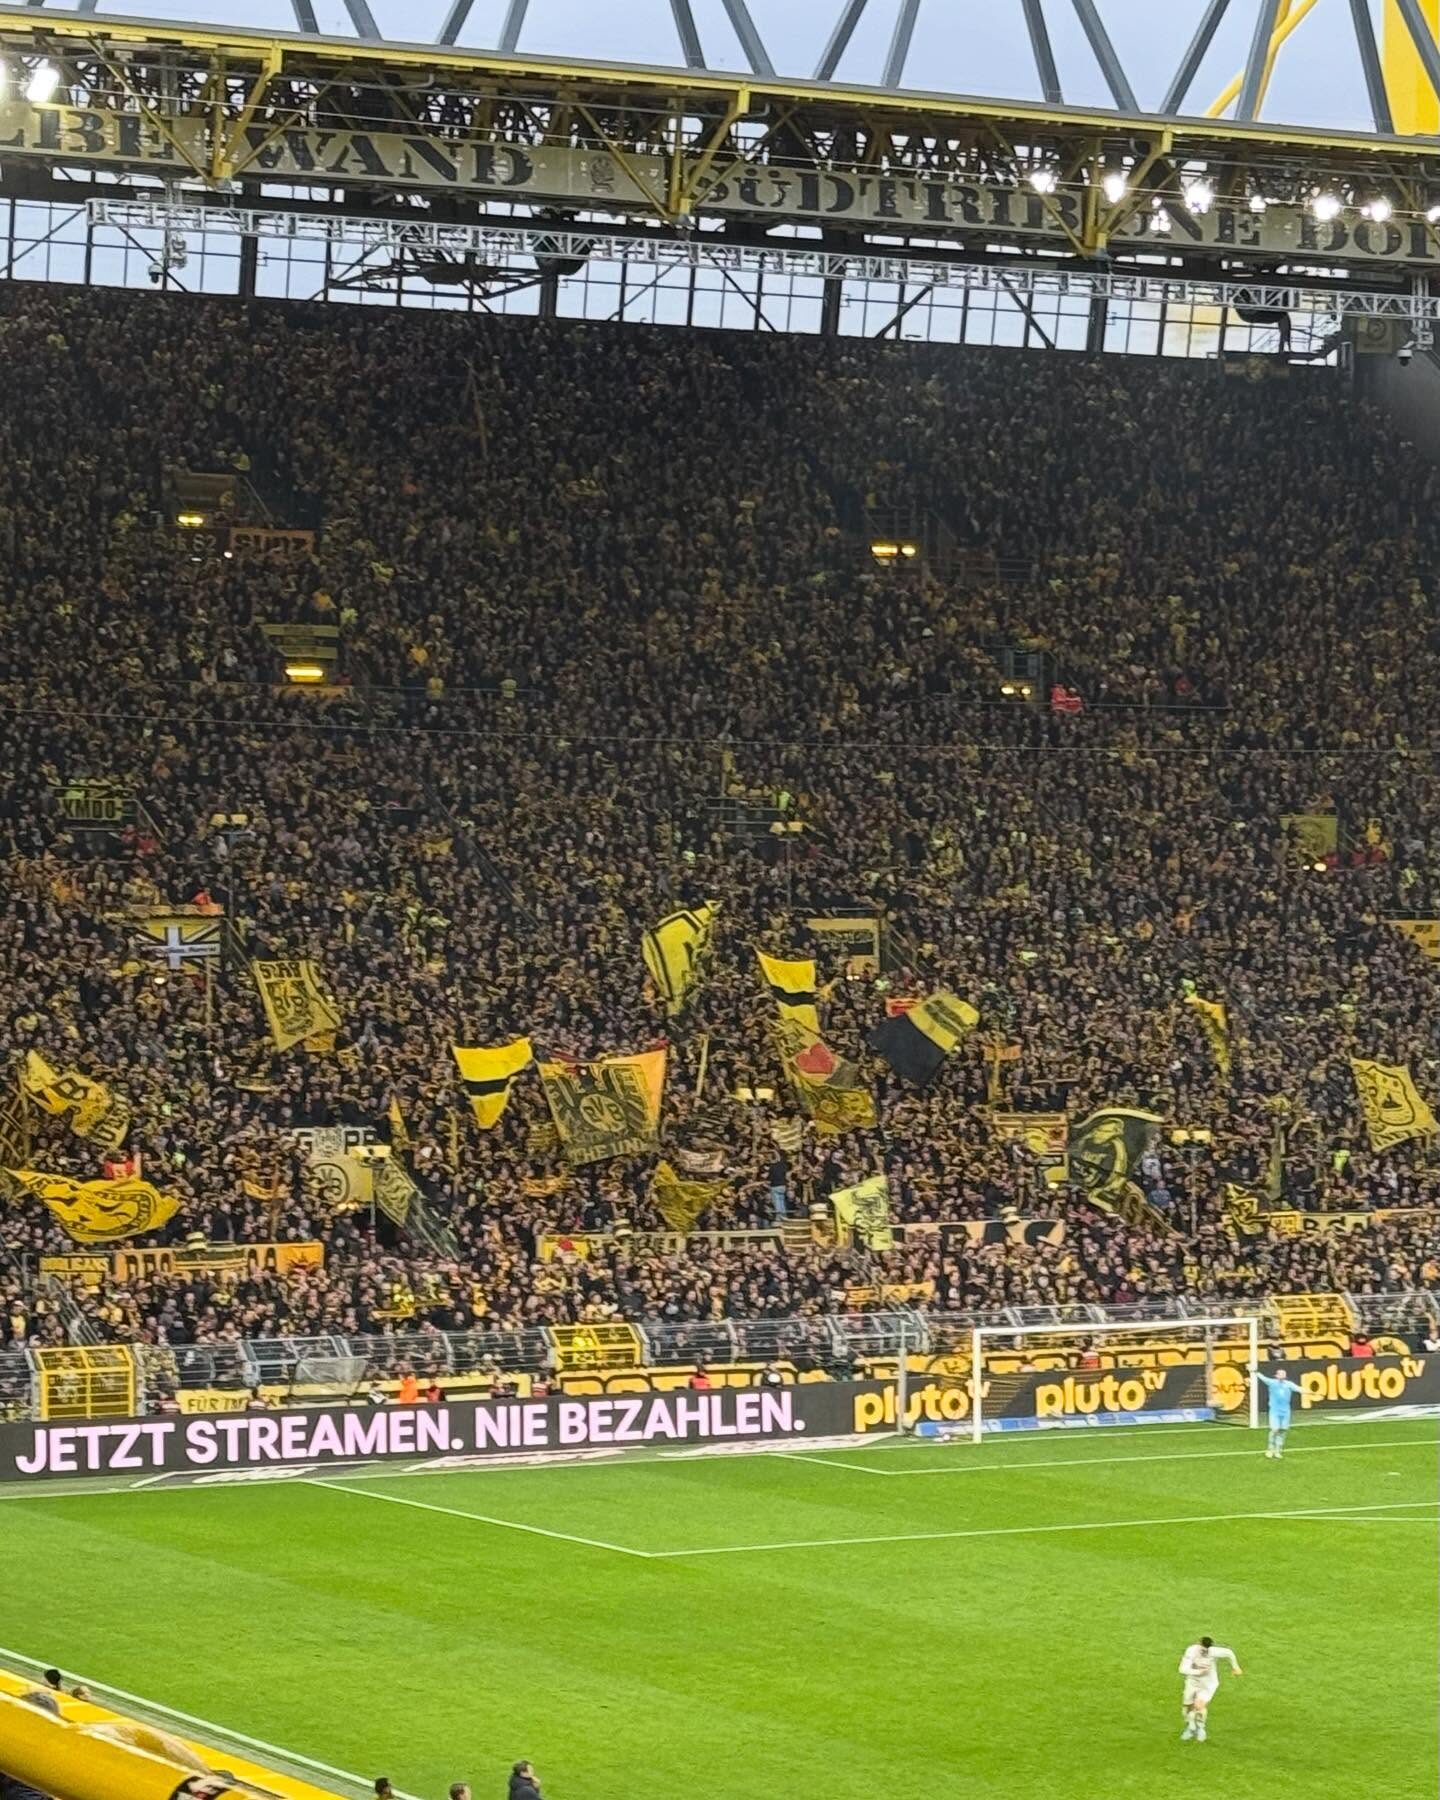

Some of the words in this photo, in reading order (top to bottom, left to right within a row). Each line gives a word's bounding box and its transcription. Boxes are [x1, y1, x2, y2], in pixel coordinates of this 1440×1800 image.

[243, 127, 533, 186] WAND
[1035, 1374, 1146, 1418] pluto
[1300, 1363, 1406, 1409] pluto
[16, 1422, 175, 1474] JETZT
[186, 1409, 463, 1464] STREAMEN.
[475, 1404, 548, 1449] NIE
[559, 1392, 806, 1446] BEZAHLEN.
